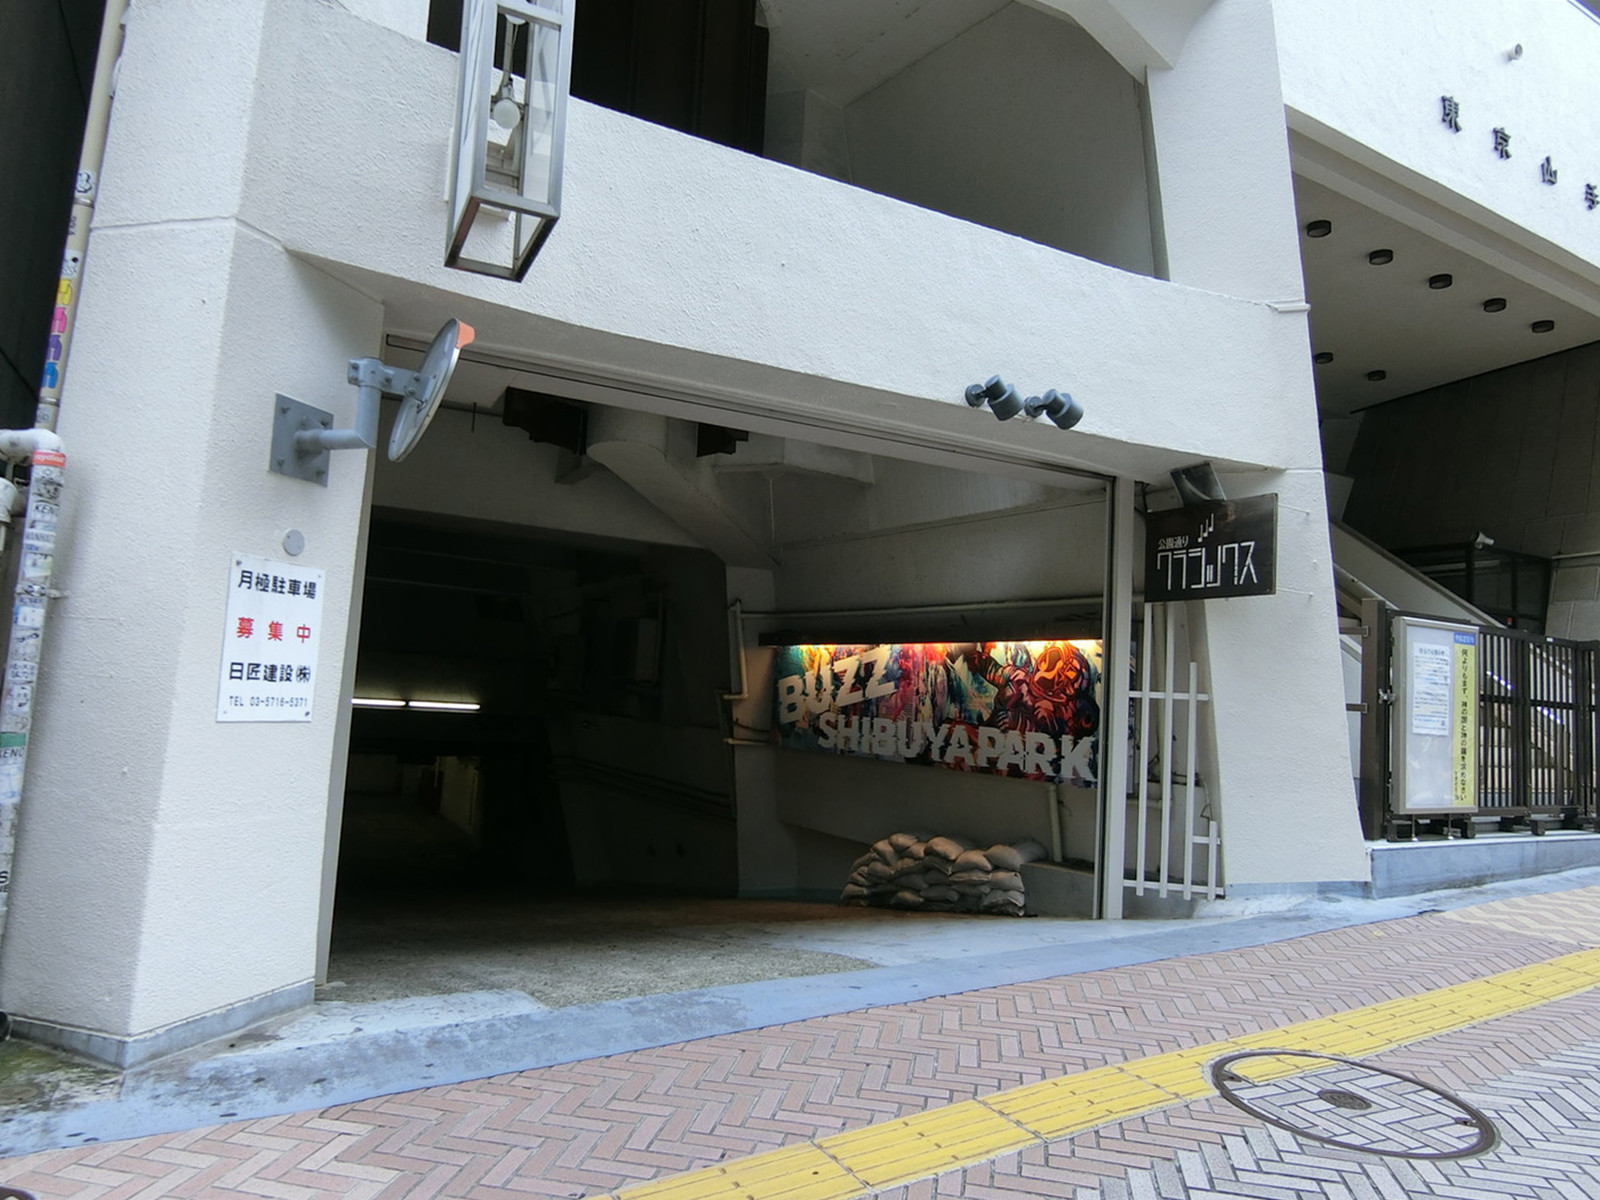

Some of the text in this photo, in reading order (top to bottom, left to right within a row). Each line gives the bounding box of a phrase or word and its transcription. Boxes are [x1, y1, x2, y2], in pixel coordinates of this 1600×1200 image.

[1158, 535, 1189, 550] 公園通り
[1157, 541, 1258, 591] クラシックス
[238, 569, 317, 600] 月極駐車場
[777, 645, 896, 725] BUZZ
[229, 695, 244, 707] TEL
